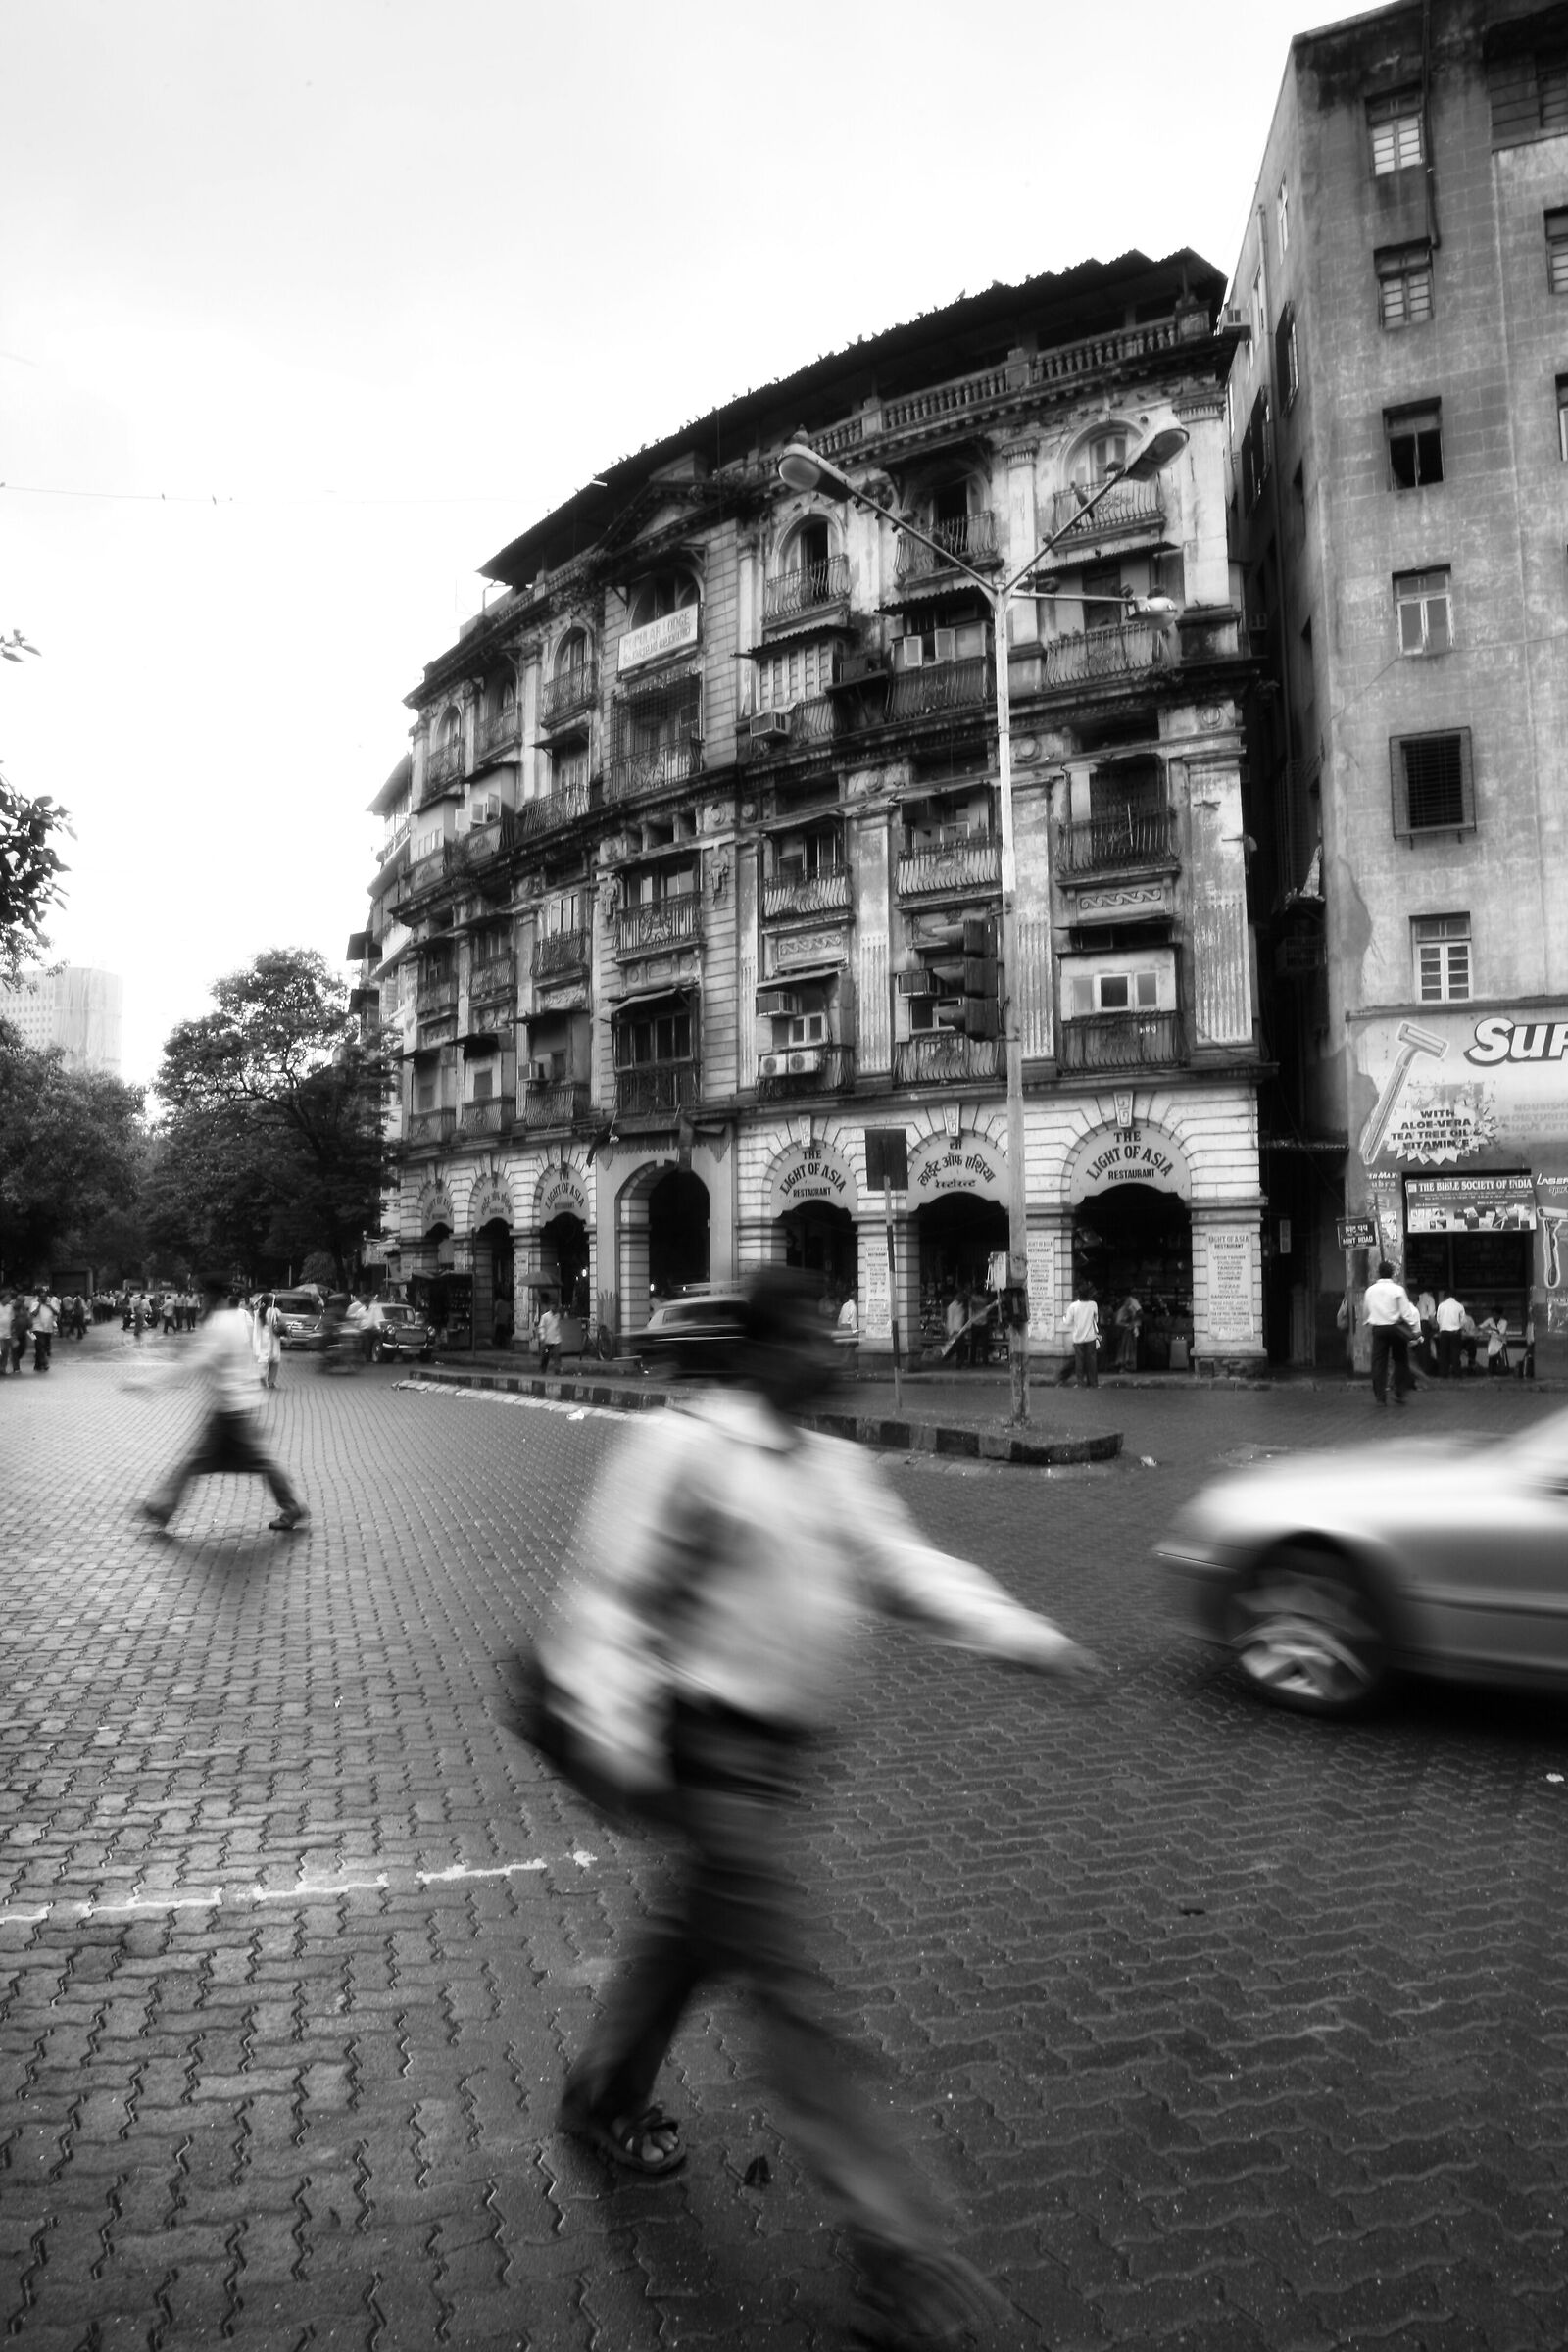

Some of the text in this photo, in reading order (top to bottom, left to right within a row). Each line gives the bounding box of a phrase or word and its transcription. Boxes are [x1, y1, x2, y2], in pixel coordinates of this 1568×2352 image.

[666, 612, 690, 633] LODGE
[1421, 1109, 1455, 1118] WITH
[1401, 1119, 1470, 1130] ALOE-VERA
[1114, 1131, 1142, 1143] THE
[1418, 1130, 1448, 1139] TREE
[803, 1150, 821, 1160] THE
[1086, 1145, 1173, 1180] LIGHT OF ASIA
[780, 1162, 846, 1195] LIGHT OF ASIA
[1108, 1169, 1155, 1180] RESTAURANT
[1419, 1178, 1532, 1192] THE BIBLE SOCIETY OF INDIA
[545, 1184, 561, 1210] LIGHT
[569, 1185, 584, 1207] ASIA
[793, 1187, 831, 1197] RESTAURANT
[1357, 1235, 1373, 1244] ROAD
